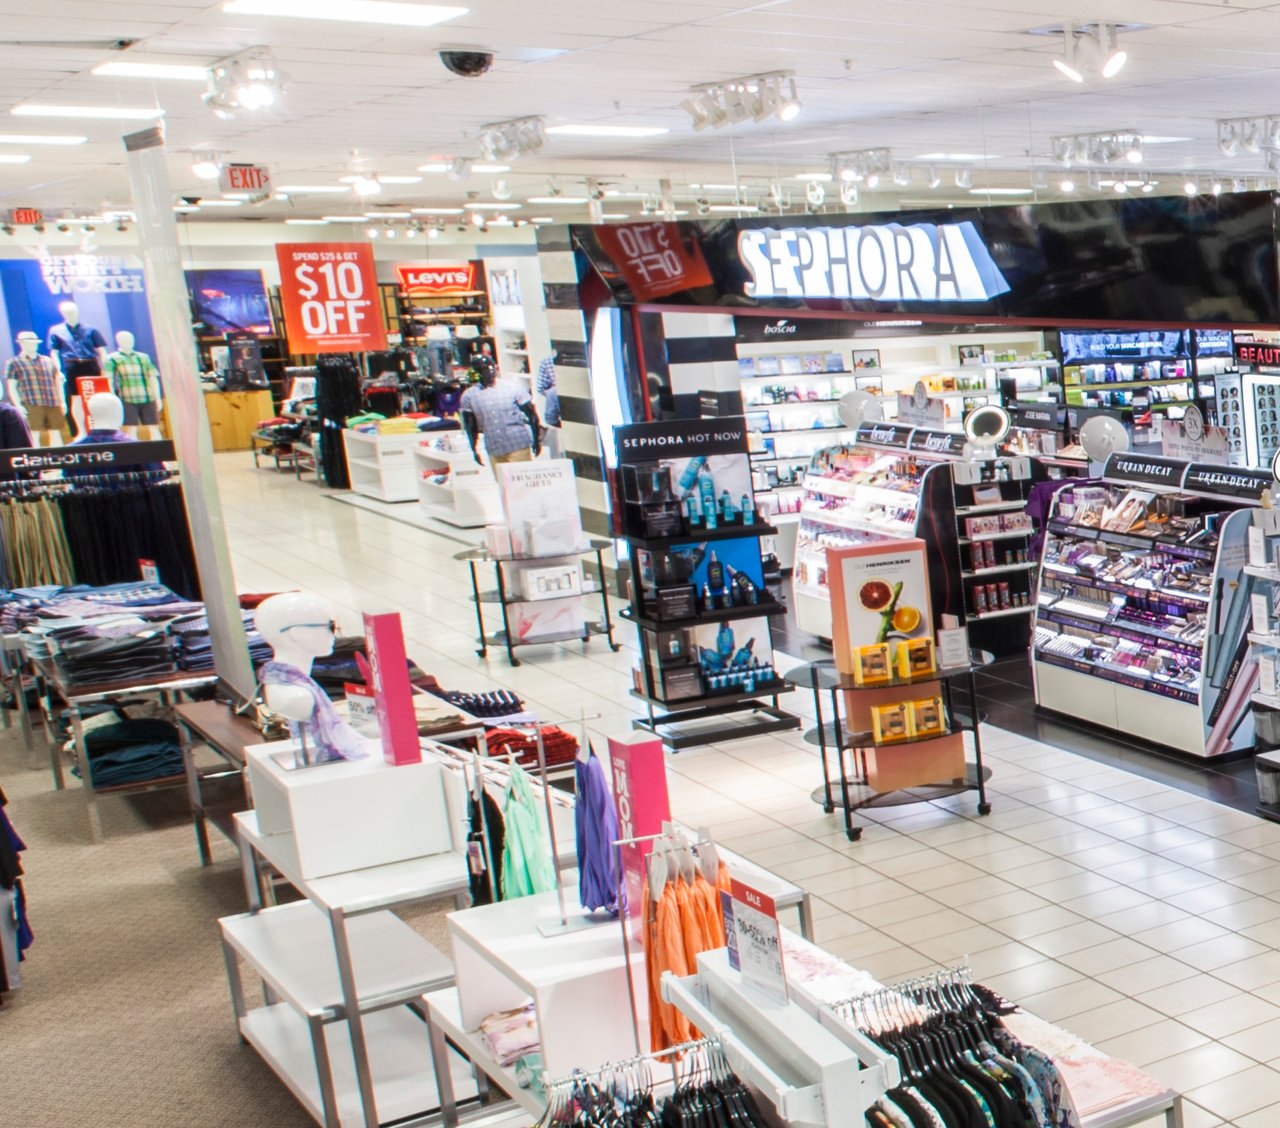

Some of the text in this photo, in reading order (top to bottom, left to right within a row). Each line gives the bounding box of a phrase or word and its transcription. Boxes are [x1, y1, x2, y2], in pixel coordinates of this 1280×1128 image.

[229, 168, 262, 189] EXIT
[15, 209, 39, 223] EXIT
[344, 252, 358, 260] GET
[738, 225, 972, 300] SEPHORA
[48, 276, 144, 294] WORTH
[295, 262, 363, 299] $10
[764, 323, 796, 335] boscia
[1240, 347, 1280, 364] BEAUT
[1187, 417, 1199, 430] 3X
[624, 432, 741, 447] SEPHORA HOT NOW
[11, 450, 115, 468] claiborne
[1117, 462, 1172, 476] URBAN DECAY
[1199, 472, 1260, 488] URBAN DECAY
[349, 701, 366, 713] 50%
[614, 769, 636, 849] MOM
[746, 891, 762, 907] SALE
